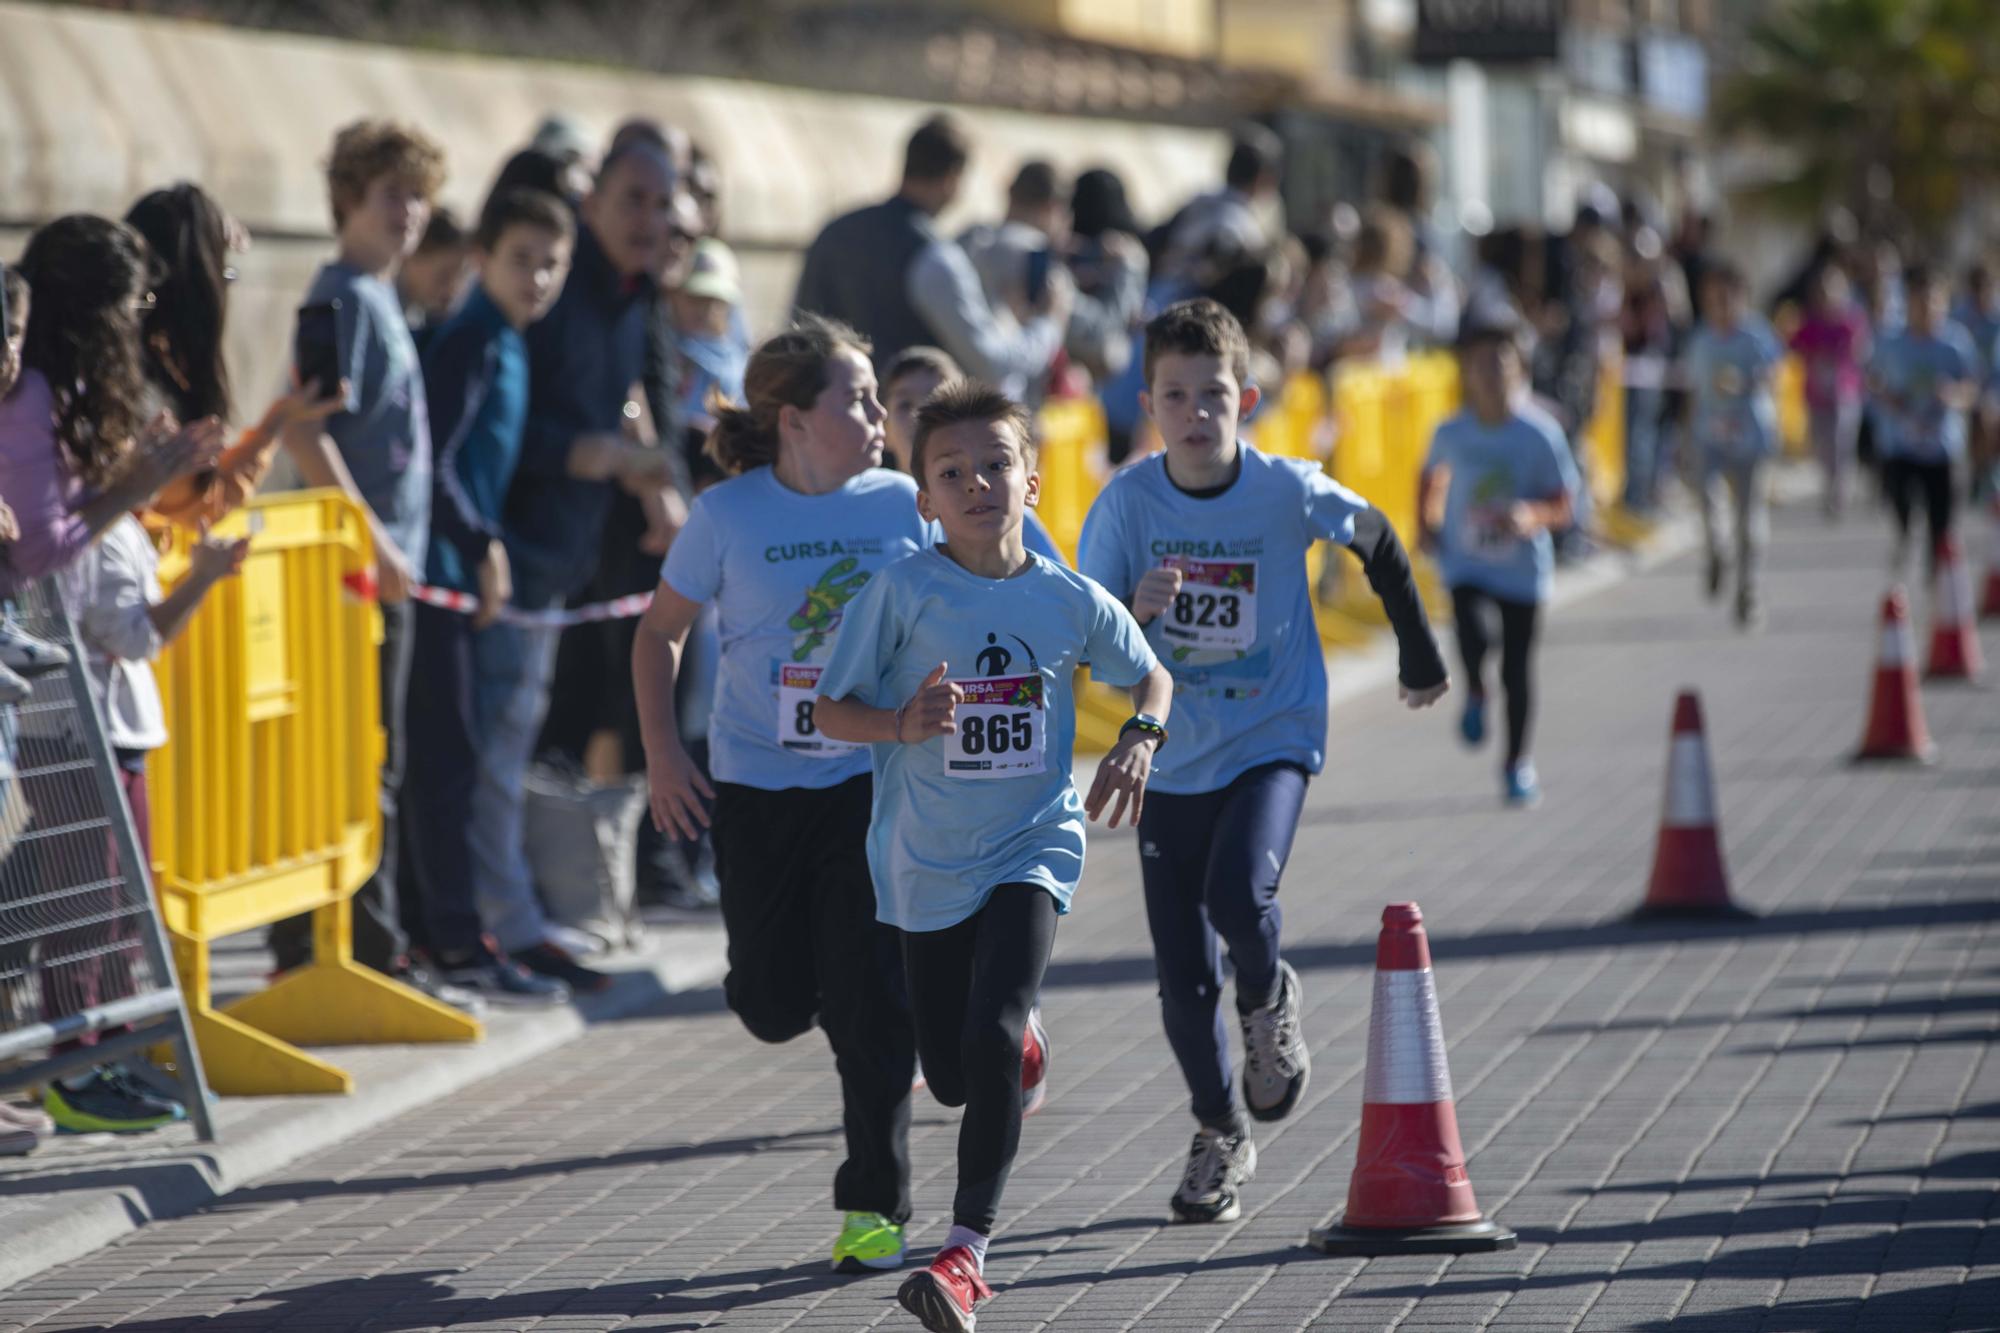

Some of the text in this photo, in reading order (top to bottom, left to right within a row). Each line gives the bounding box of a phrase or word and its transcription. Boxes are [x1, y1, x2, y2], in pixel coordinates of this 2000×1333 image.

[765, 539, 845, 563] CURSA
[1151, 540, 1227, 558] CURSA
[1174, 592, 1241, 628] 823
[786, 669, 818, 681] CURS
[959, 683, 994, 694] URSA
[796, 700, 816, 736] 8
[962, 712, 1032, 755] 865
